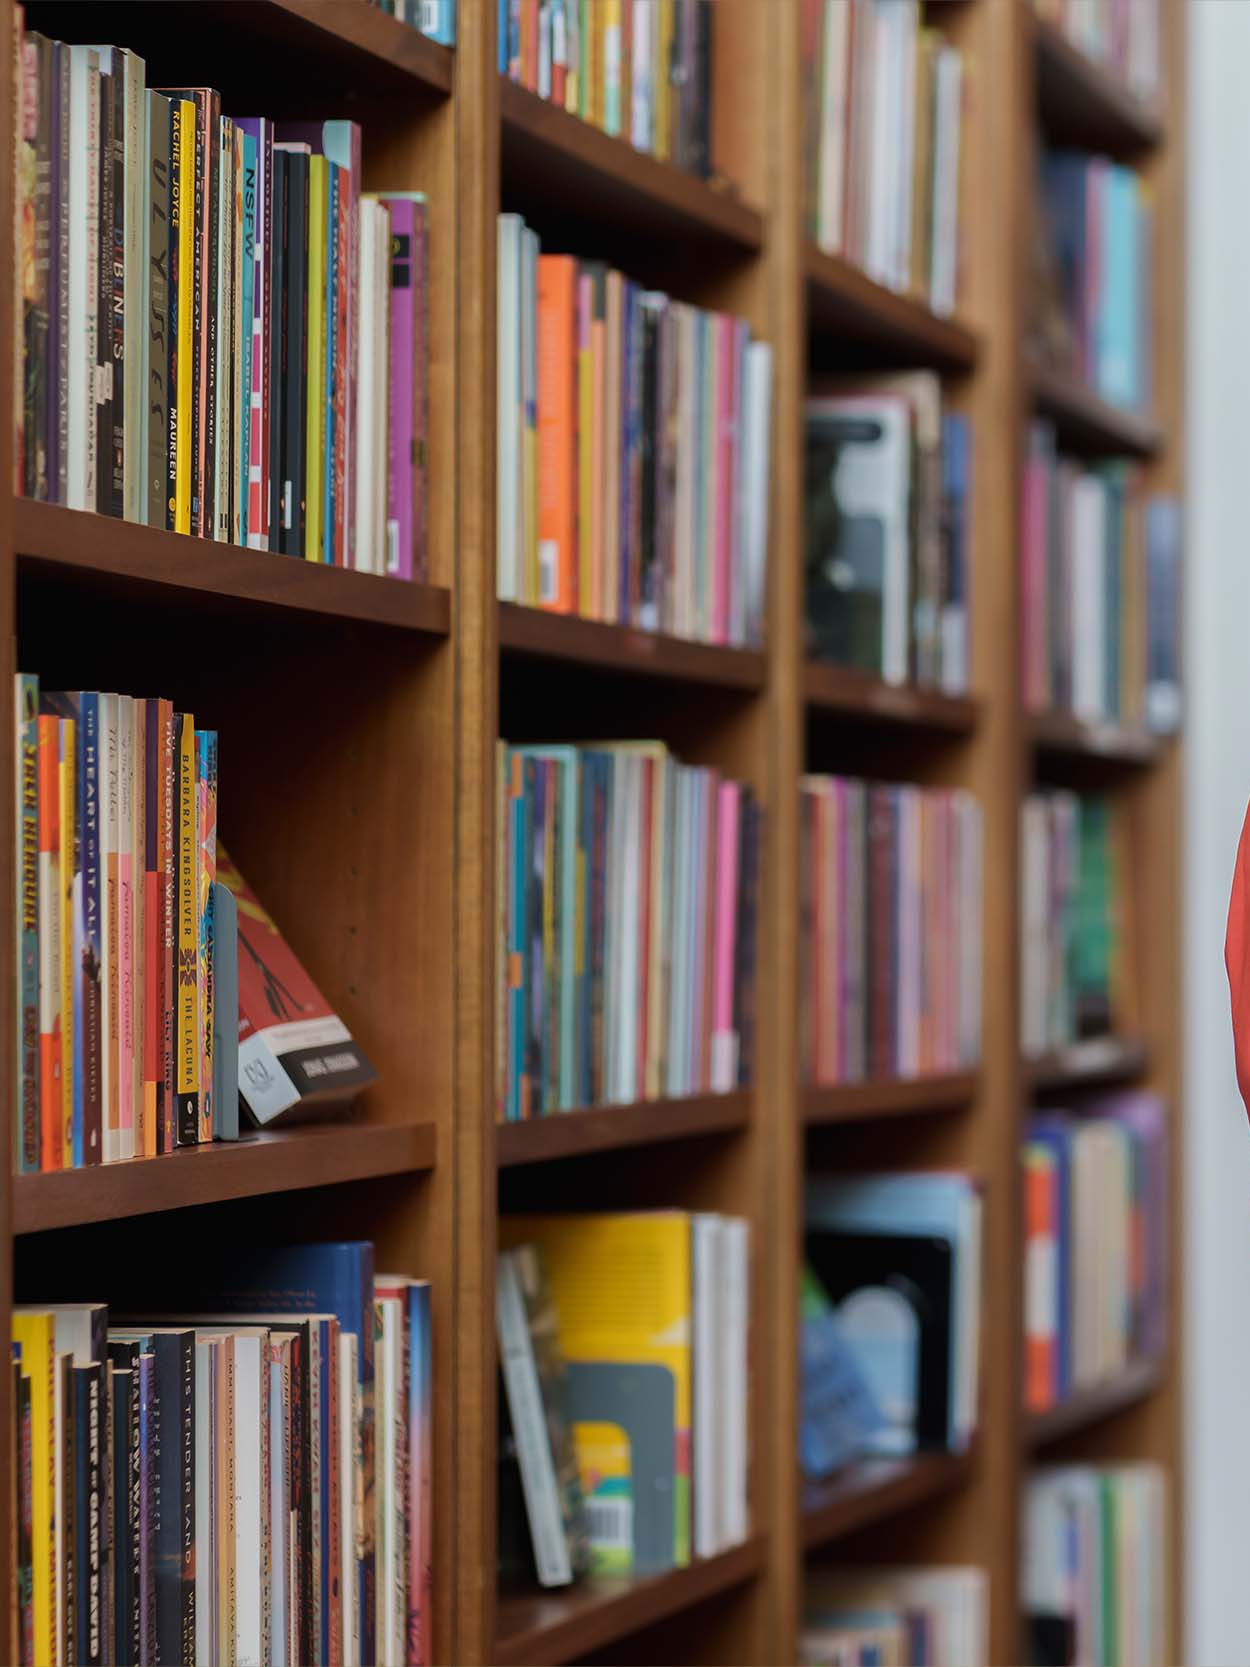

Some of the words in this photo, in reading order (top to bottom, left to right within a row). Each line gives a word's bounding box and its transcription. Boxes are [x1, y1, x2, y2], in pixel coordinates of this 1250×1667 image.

[172, 110, 180, 171] RACHEL
[245, 167, 256, 259] NSFW
[114, 228, 124, 361] DUBLINERS
[151, 157, 168, 425] ULYSSES
[169, 407, 178, 481] MAUREEN
[165, 719, 173, 758] FIVE
[87, 746, 96, 830] HEART
[165, 765, 173, 851] TUESDAYS
[181, 754, 191, 829] BARBARA
[88, 867, 96, 888] IT
[165, 857, 173, 875] IN
[183, 835, 193, 936] KINGSOLVER
[88, 896, 97, 936] ALL
[165, 883, 174, 949] WINTER
[184, 995, 193, 1022] THE
[184, 1028, 193, 1086] LACUNA
[89, 1378, 99, 1465] NIGHT
[184, 1404, 192, 1493] TENDER
[89, 1491, 99, 1571] CAMP
[89, 1573, 99, 1658] DAVID
